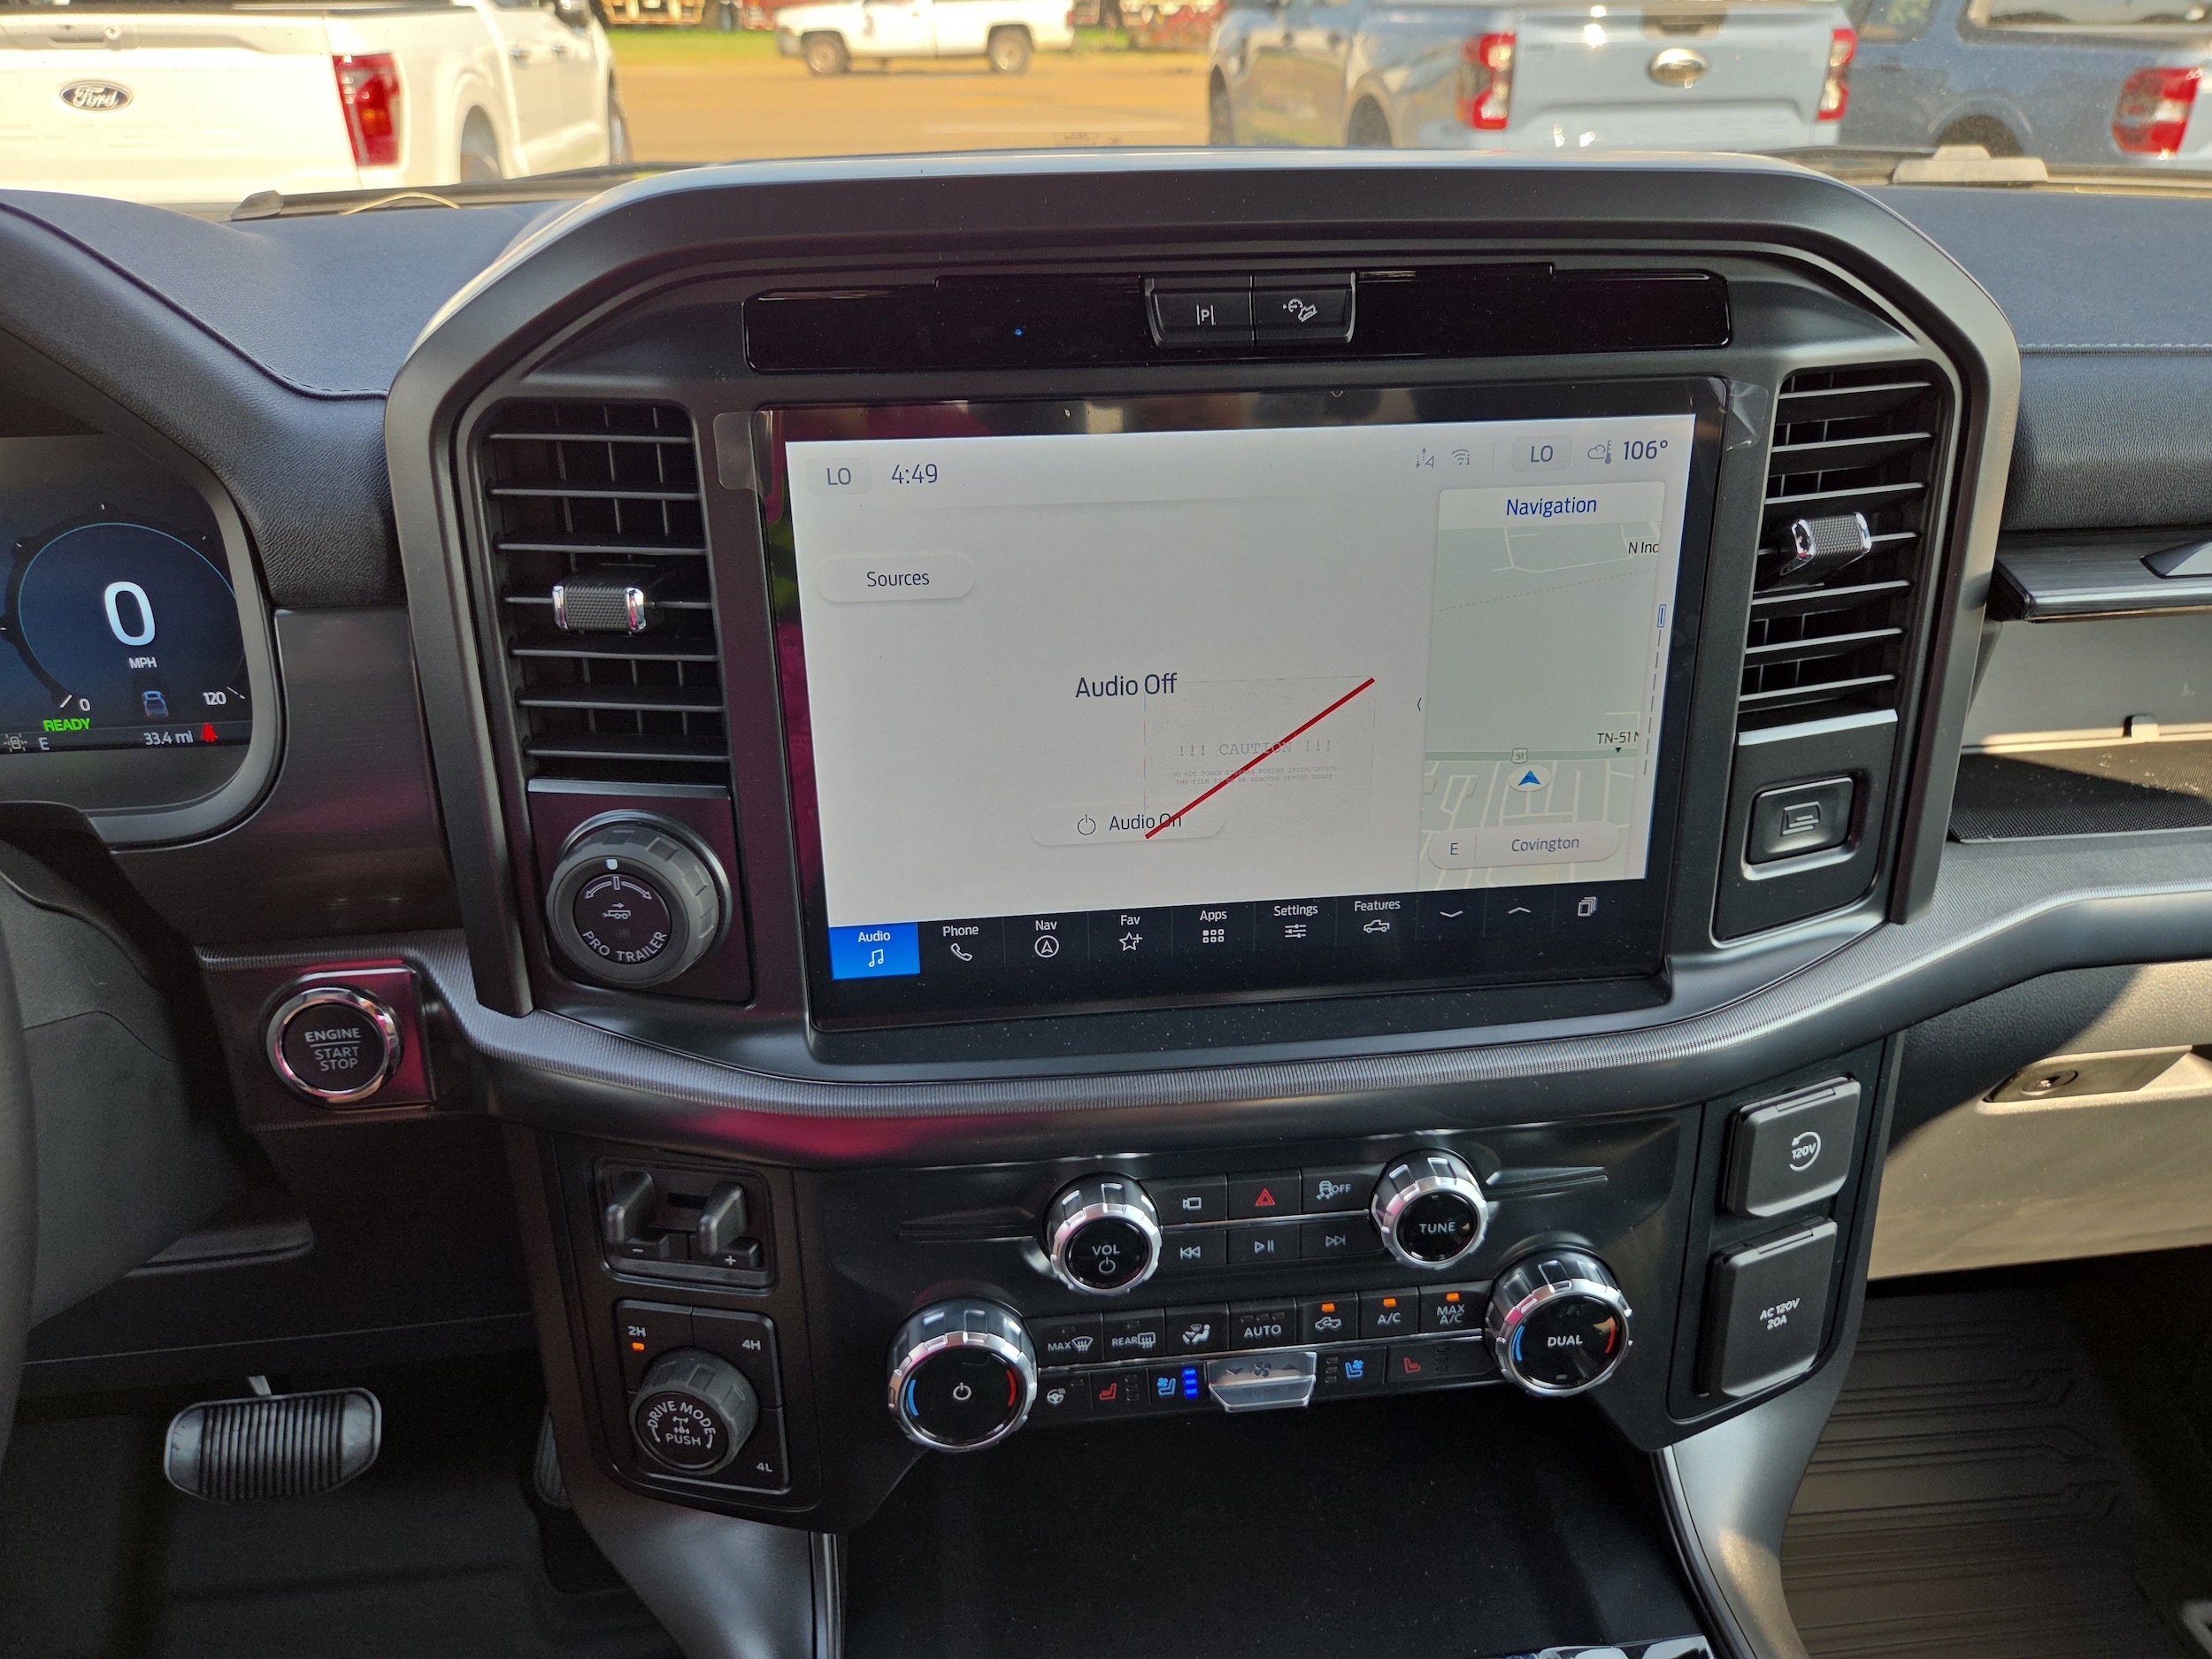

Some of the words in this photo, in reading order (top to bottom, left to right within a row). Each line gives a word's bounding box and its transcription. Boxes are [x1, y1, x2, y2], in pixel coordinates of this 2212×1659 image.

[73, 86, 119, 108] Ford
[1529, 445, 1554, 463] LO
[1623, 440, 1669, 460] 106°
[826, 467, 852, 486] LO
[890, 464, 939, 485] 4:49
[1506, 496, 1597, 518] Navigation
[1628, 541, 1638, 554] N
[866, 570, 930, 588] Sources
[104, 581, 156, 646] 0
[129, 657, 157, 669] MPH
[1075, 674, 1139, 698] Audio
[1144, 672, 1179, 695] Off
[79, 698, 91, 711] 0
[204, 691, 227, 705] 120
[43, 718, 91, 732] READY
[38, 736, 50, 750] E
[143, 731, 173, 745] 33.4
[176, 730, 194, 743] mi
[1596, 731, 1631, 745] TN-51
[1219, 741, 1292, 756] CAUTION
[1109, 814, 1156, 831] Audio
[1159, 812, 1182, 828] On
[1449, 842, 1459, 856] E
[1511, 837, 1579, 853] Covington
[1273, 904, 1318, 918] Settings
[1354, 899, 1401, 912] Features
[1120, 914, 1141, 926] Fav
[1199, 909, 1228, 923] Apps
[942, 925, 979, 937] Phone
[1035, 919, 1057, 931] Nav
[857, 930, 891, 942] Audio
[582, 930, 611, 956] PRO
[616, 931, 668, 963] TRAILER
[304, 1027, 362, 1042] ENGINE
[314, 1046, 360, 1061] START
[320, 1057, 359, 1071] STOP
[1791, 1142, 1817, 1160] 120V
[1333, 1183, 1352, 1194] OFF
[1418, 1221, 1456, 1234] TUNE
[1092, 1244, 1121, 1256] VOL
[1437, 1303, 1466, 1316] MAX
[1759, 1308, 1775, 1321] AC
[1776, 1297, 1801, 1316] 120V
[1377, 1312, 1402, 1325] A/C
[1439, 1314, 1463, 1325] A/C
[1767, 1315, 1787, 1331] 20A
[627, 1325, 647, 1337] 2H
[1243, 1324, 1282, 1338] AUTO
[741, 1339, 762, 1350] 4H
[1048, 1341, 1071, 1352] MAX
[1111, 1337, 1138, 1348] REAR
[1547, 1335, 1584, 1348] DUAL
[647, 1401, 677, 1429] DRIVE
[680, 1402, 717, 1435] MODE
[665, 1432, 702, 1447] PUSH
[756, 1462, 773, 1473] 4L
